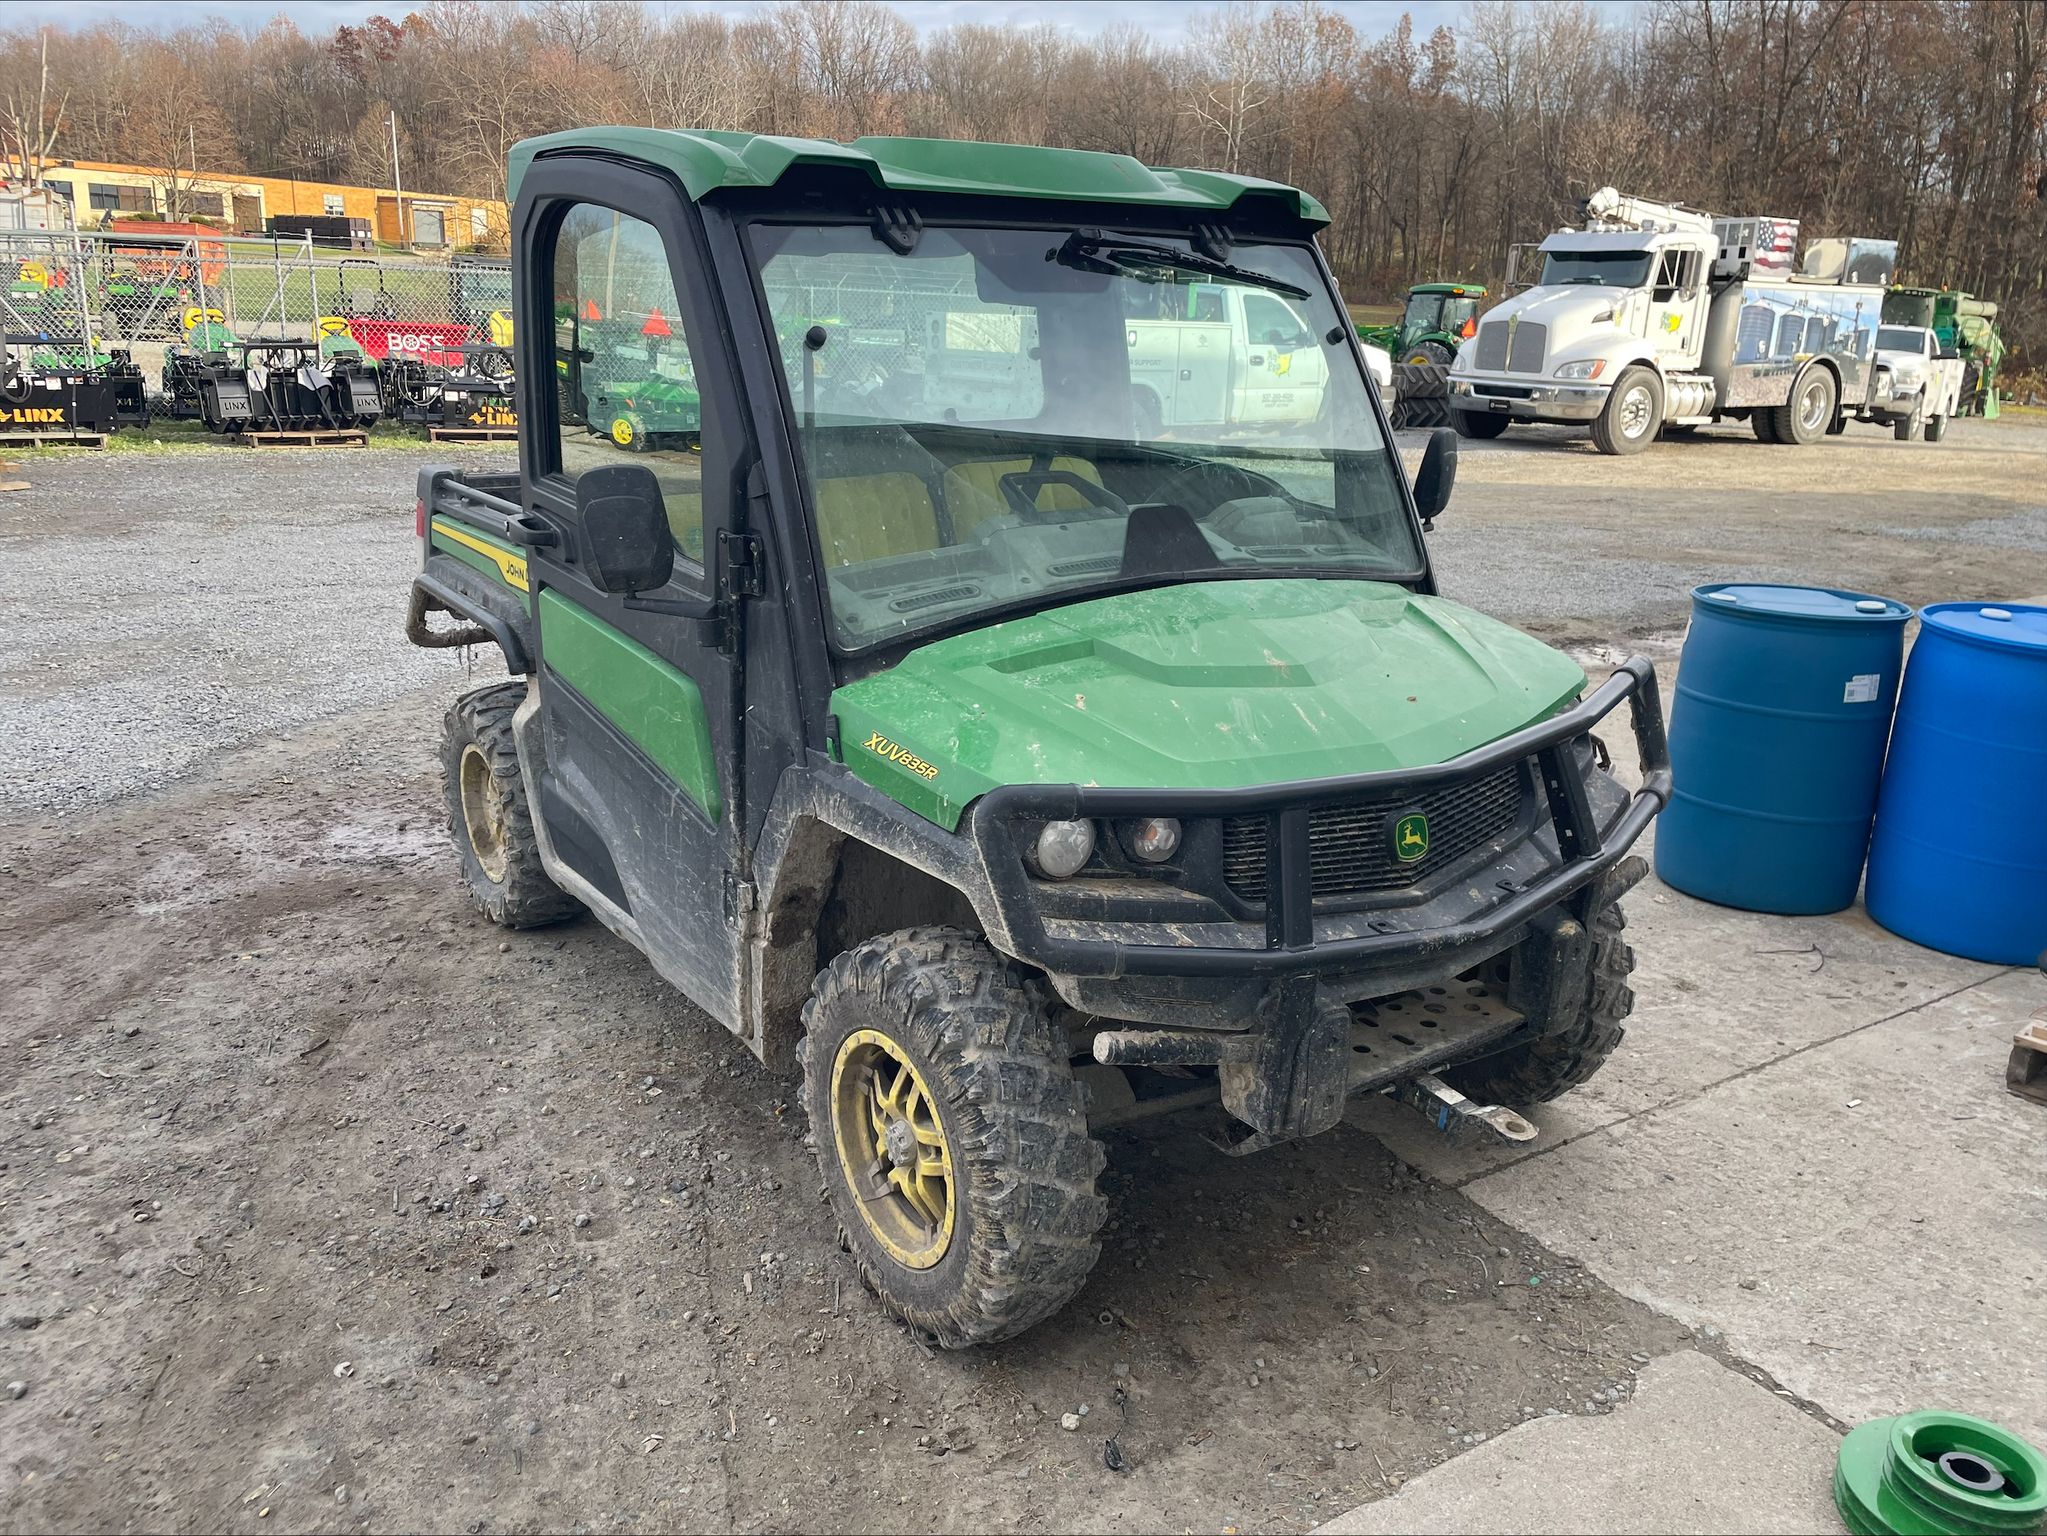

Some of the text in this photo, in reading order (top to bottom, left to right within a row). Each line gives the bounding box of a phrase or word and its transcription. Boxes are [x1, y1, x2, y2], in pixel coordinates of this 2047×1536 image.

[387, 333, 445, 352] BOSS
[224, 401, 247, 411] LINX
[356, 398, 378, 407] LINX
[12, 408, 66, 423] LINX
[506, 560, 524, 581] JOHN
[863, 731, 939, 781] XUV835R
